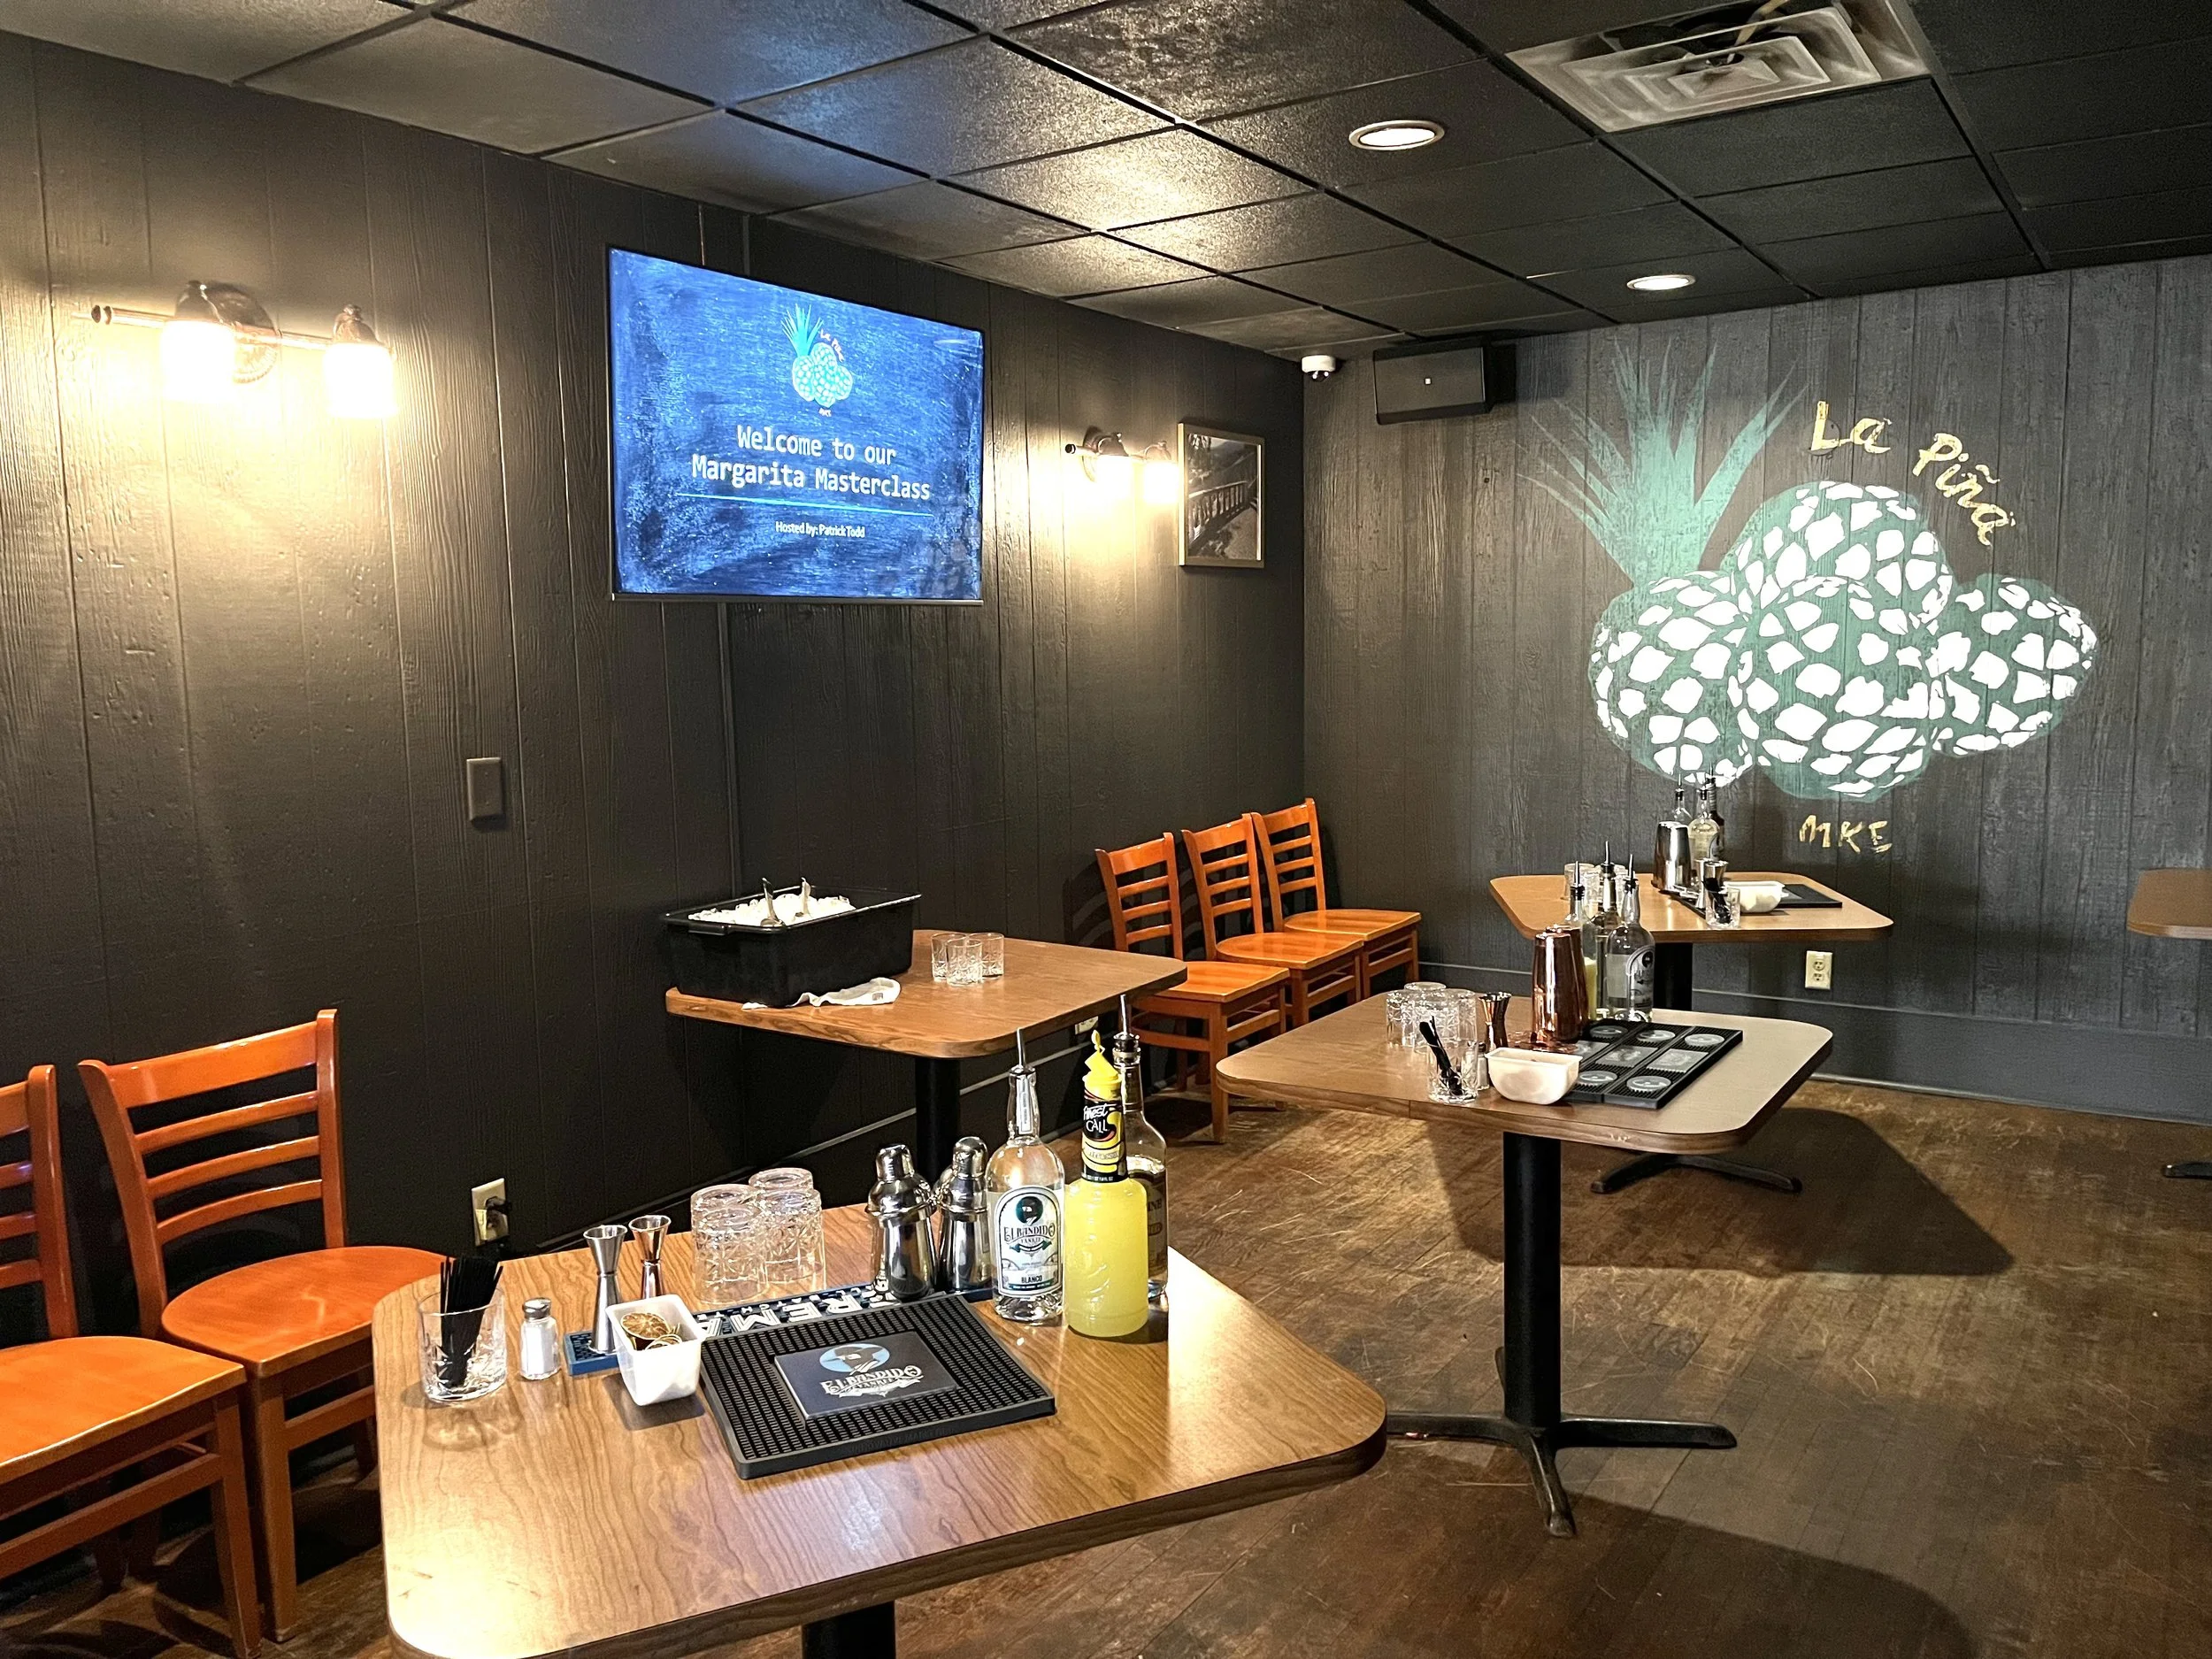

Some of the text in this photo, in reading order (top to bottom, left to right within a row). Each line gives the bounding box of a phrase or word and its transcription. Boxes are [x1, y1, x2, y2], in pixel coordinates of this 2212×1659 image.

[737, 425, 896, 465] Welcome to our
[691, 454, 930, 500] Margarita Masterclass
[1811, 401, 2016, 546] La Piña
[775, 521, 865, 538] Hosted by: Patrick Todd
[1800, 815, 1893, 853] MKE
[1086, 1118, 1108, 1133] CALL
